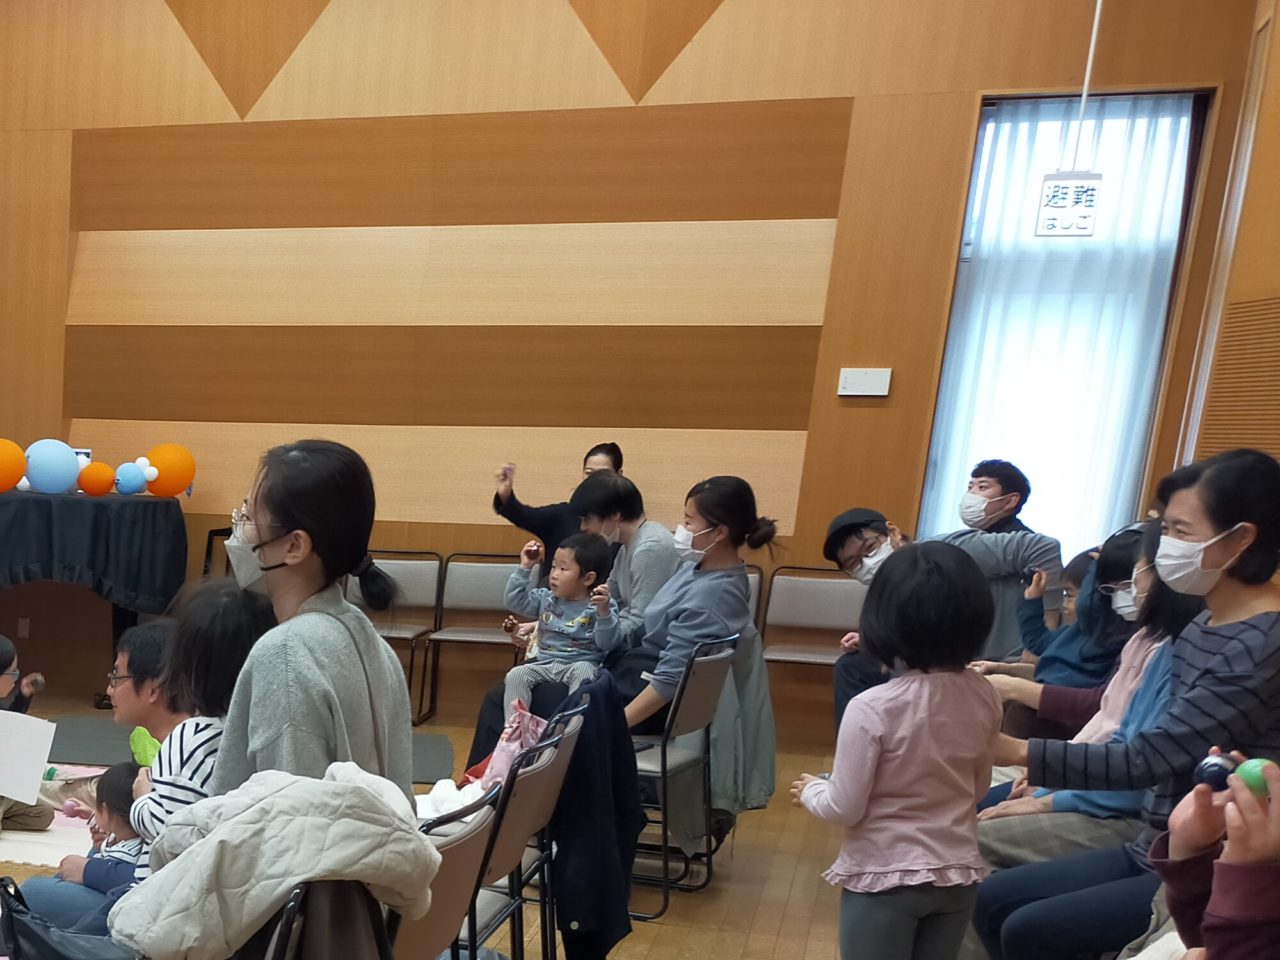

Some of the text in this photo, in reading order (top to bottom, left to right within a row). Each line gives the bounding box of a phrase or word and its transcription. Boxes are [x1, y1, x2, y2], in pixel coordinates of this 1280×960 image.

[1043, 185, 1097, 209] 避難
[1042, 214, 1092, 231] はしご
